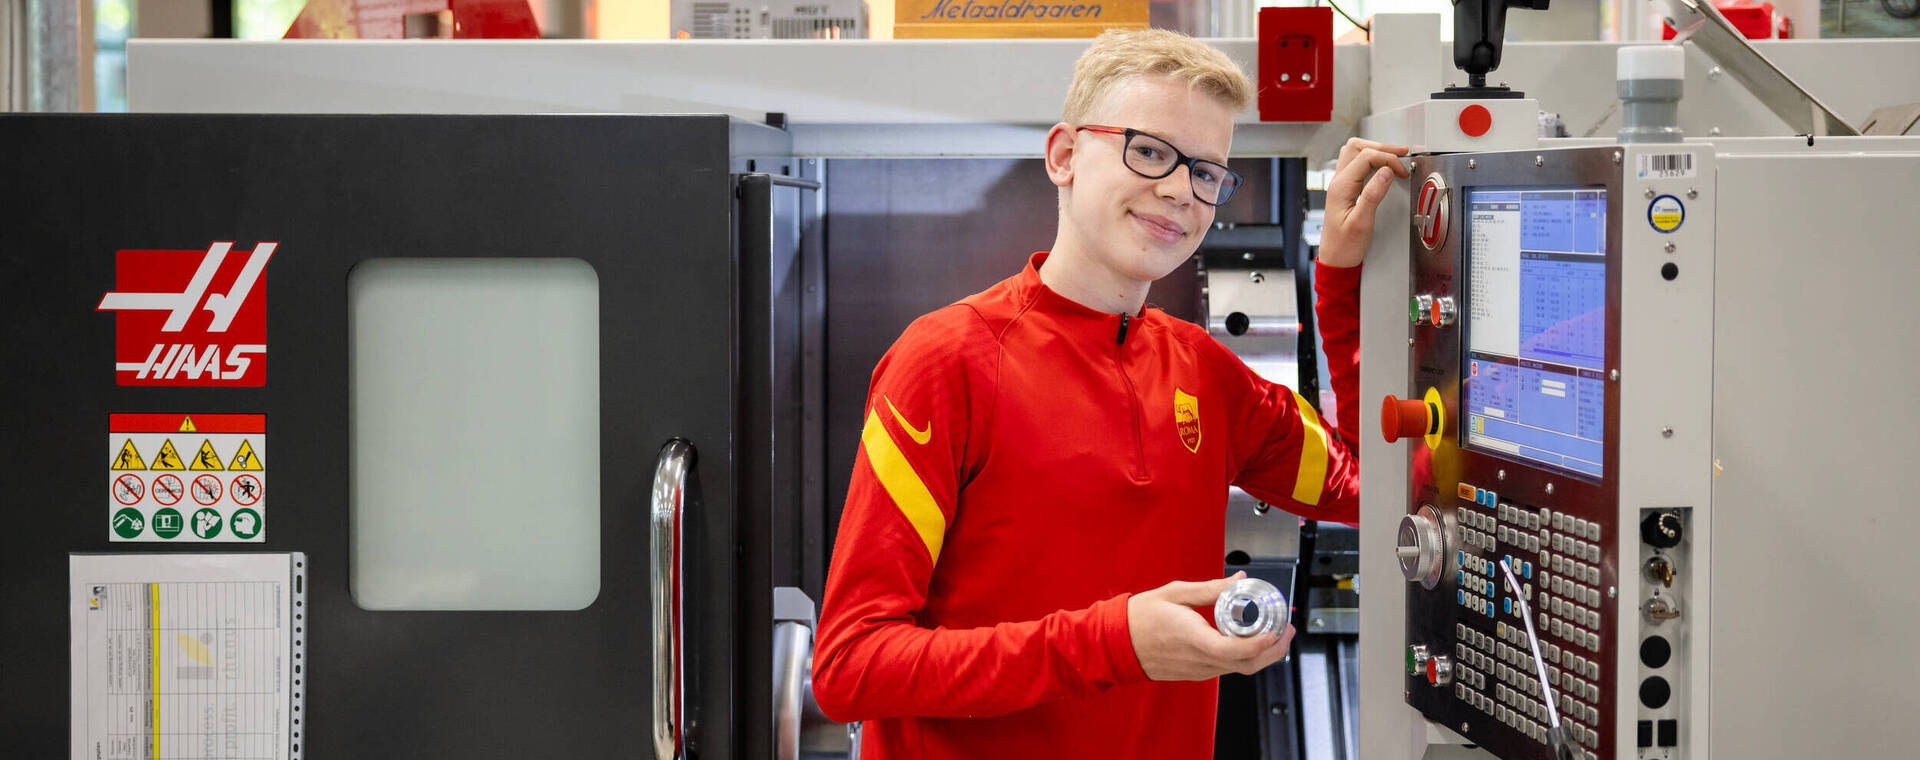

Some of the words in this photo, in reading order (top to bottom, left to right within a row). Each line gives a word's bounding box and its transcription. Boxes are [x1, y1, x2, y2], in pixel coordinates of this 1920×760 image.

[920, 0, 1100, 19] Metaaldraaien
[116, 343, 267, 380] HAAS
[1179, 426, 1198, 436] ROMA
